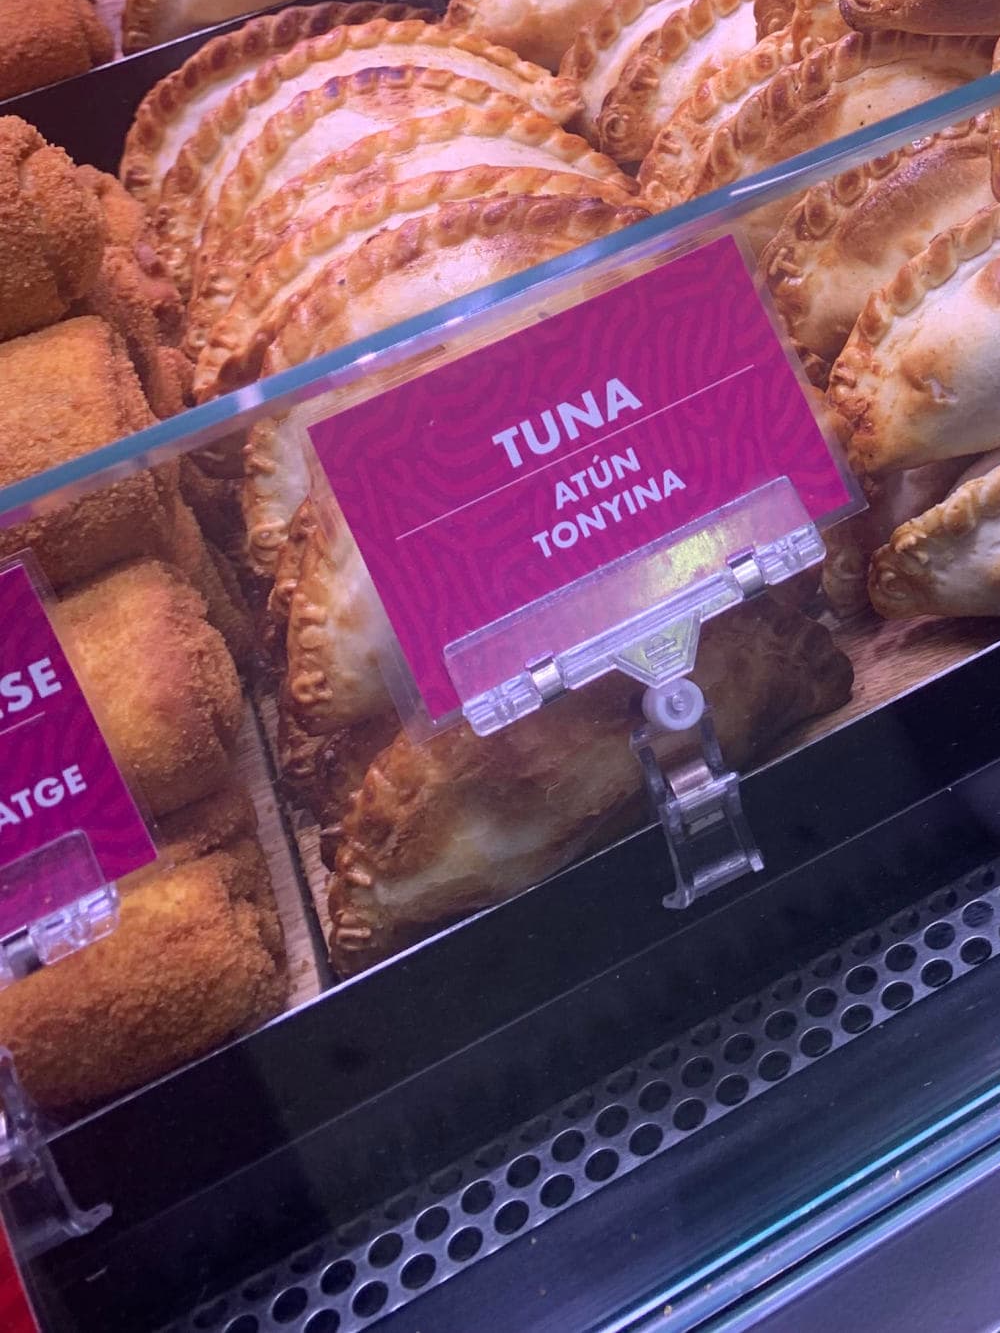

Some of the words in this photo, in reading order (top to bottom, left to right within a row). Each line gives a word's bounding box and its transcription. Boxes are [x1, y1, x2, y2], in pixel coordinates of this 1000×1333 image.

[491, 377, 642, 469] TUNA
[532, 468, 686, 559] TONYINA
[555, 447, 642, 510] ATÚN
